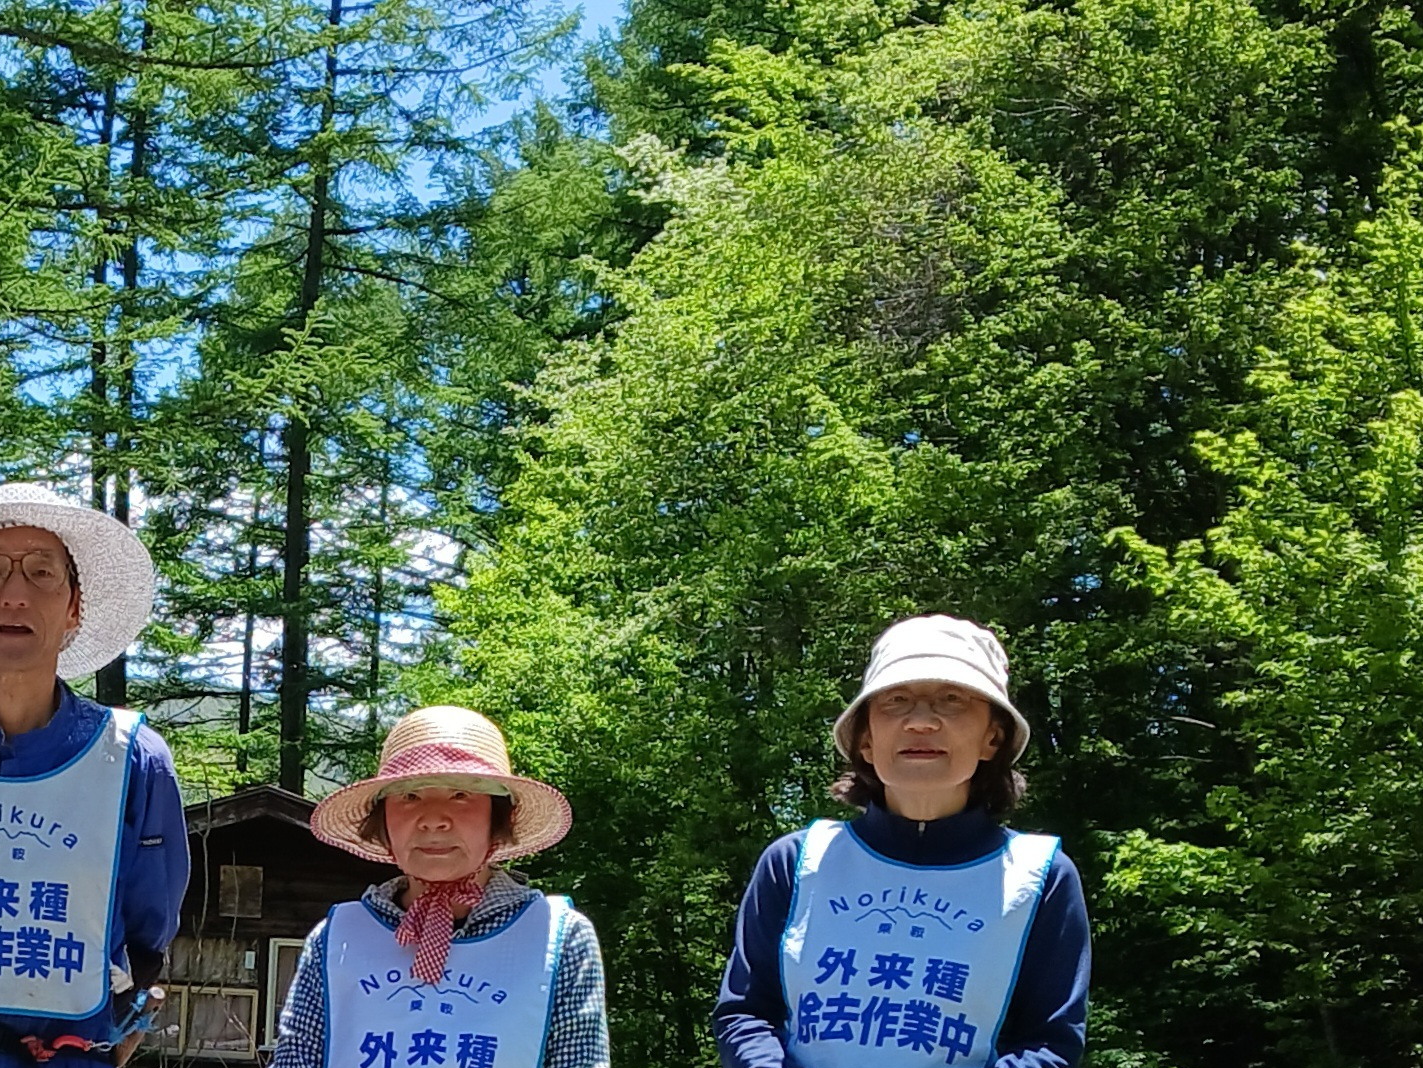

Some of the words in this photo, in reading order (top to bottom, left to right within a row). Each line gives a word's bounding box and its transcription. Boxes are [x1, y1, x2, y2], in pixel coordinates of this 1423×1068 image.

[829, 886, 985, 934] Norikura
[814, 947, 970, 1003] 外来種
[797, 991, 978, 1065] 除去作業中
